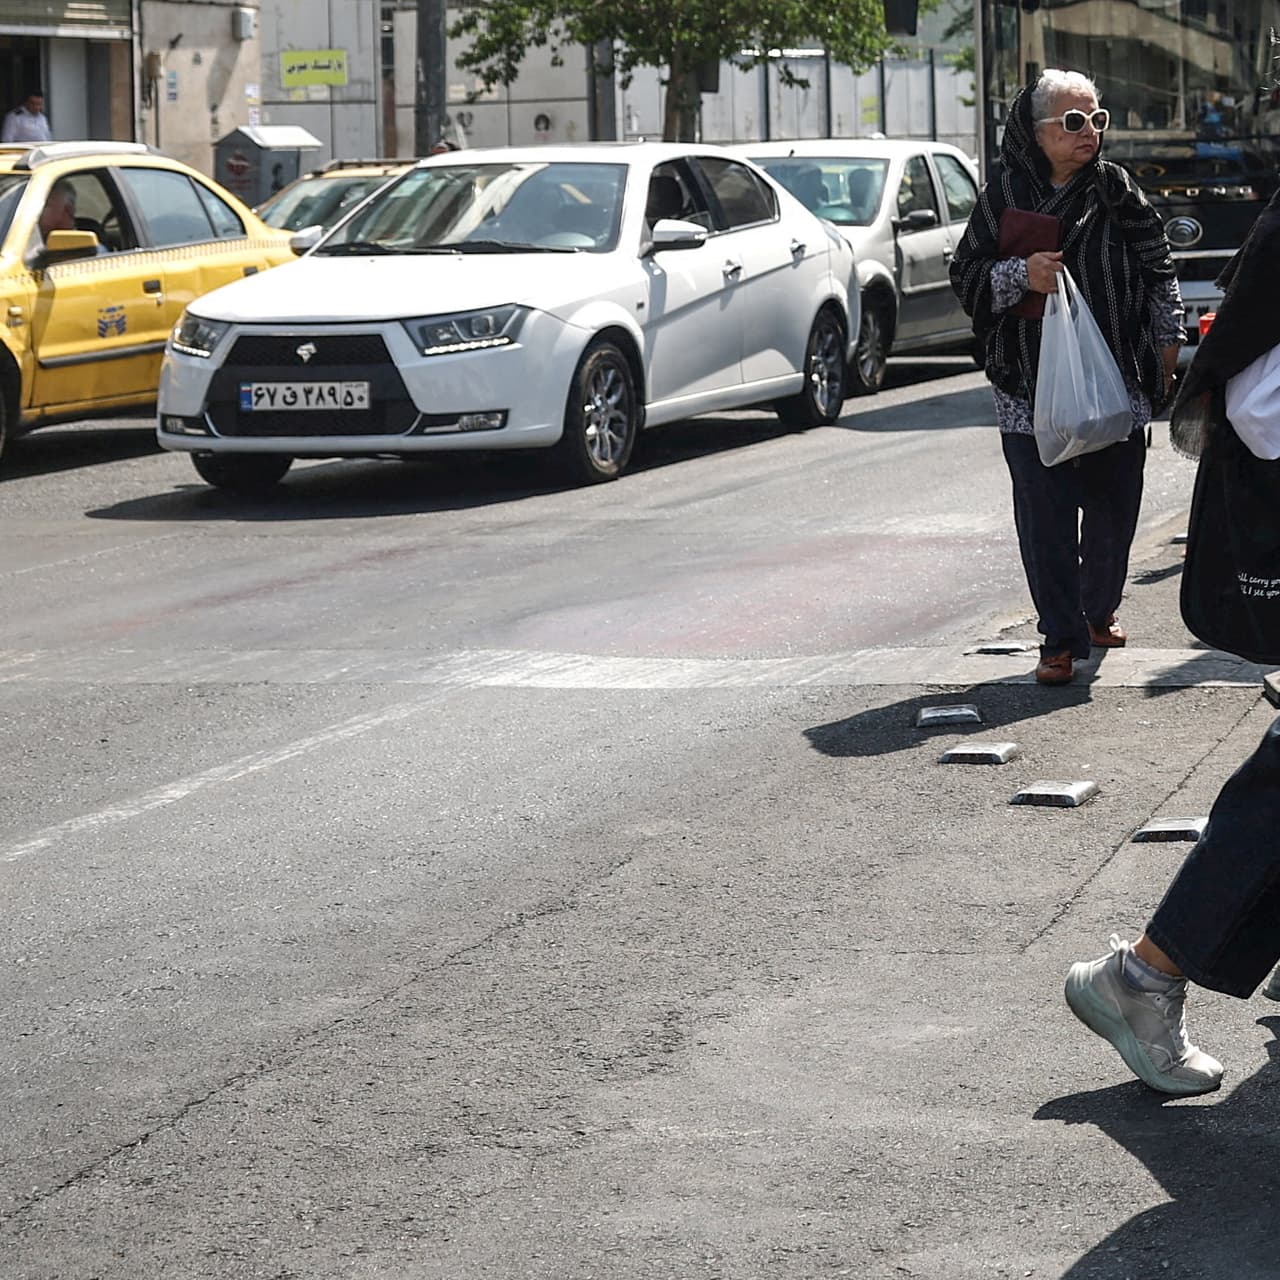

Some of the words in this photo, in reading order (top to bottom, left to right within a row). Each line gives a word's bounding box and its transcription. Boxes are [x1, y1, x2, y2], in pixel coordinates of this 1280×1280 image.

[254, 386, 277, 407] ۶۷
[303, 386, 338, 406] ۳۸۹
[343, 389, 365, 407] ۵۰
